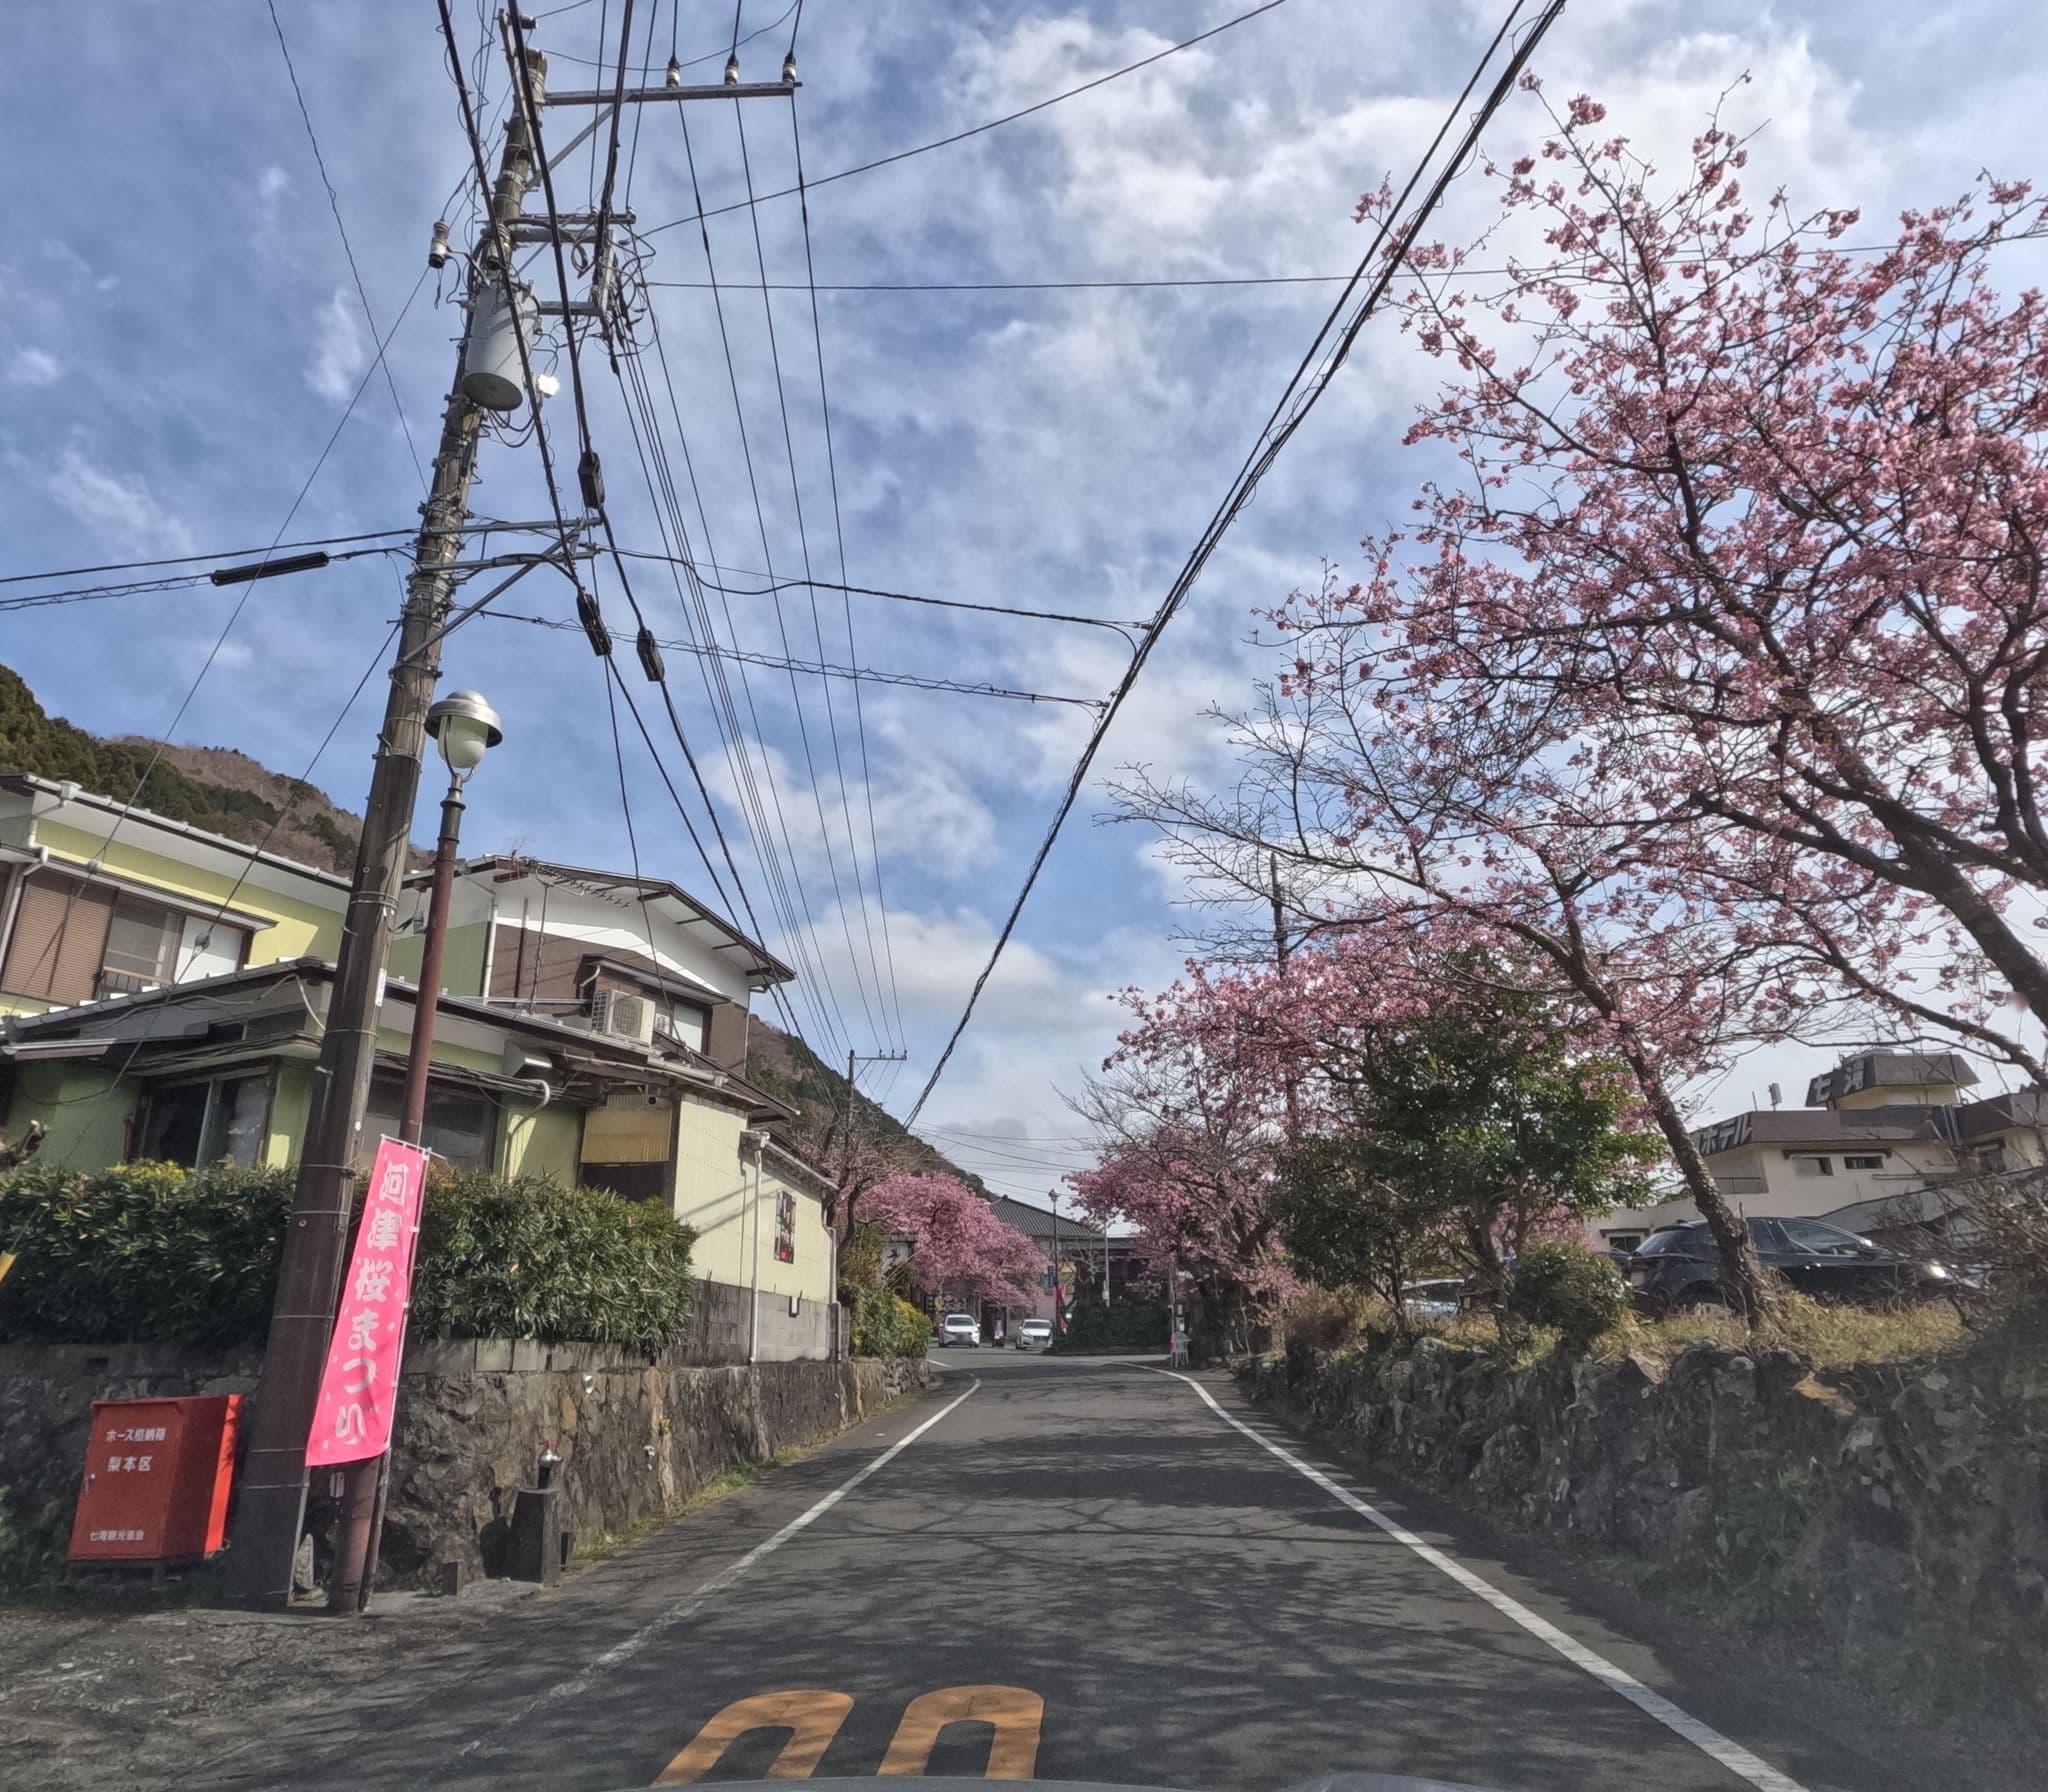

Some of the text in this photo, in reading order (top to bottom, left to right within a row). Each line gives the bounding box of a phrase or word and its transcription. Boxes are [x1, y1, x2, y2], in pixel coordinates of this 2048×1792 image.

[1701, 1112, 1752, 1154] ホテル
[335, 1162, 409, 1445] 河津桜まつり
